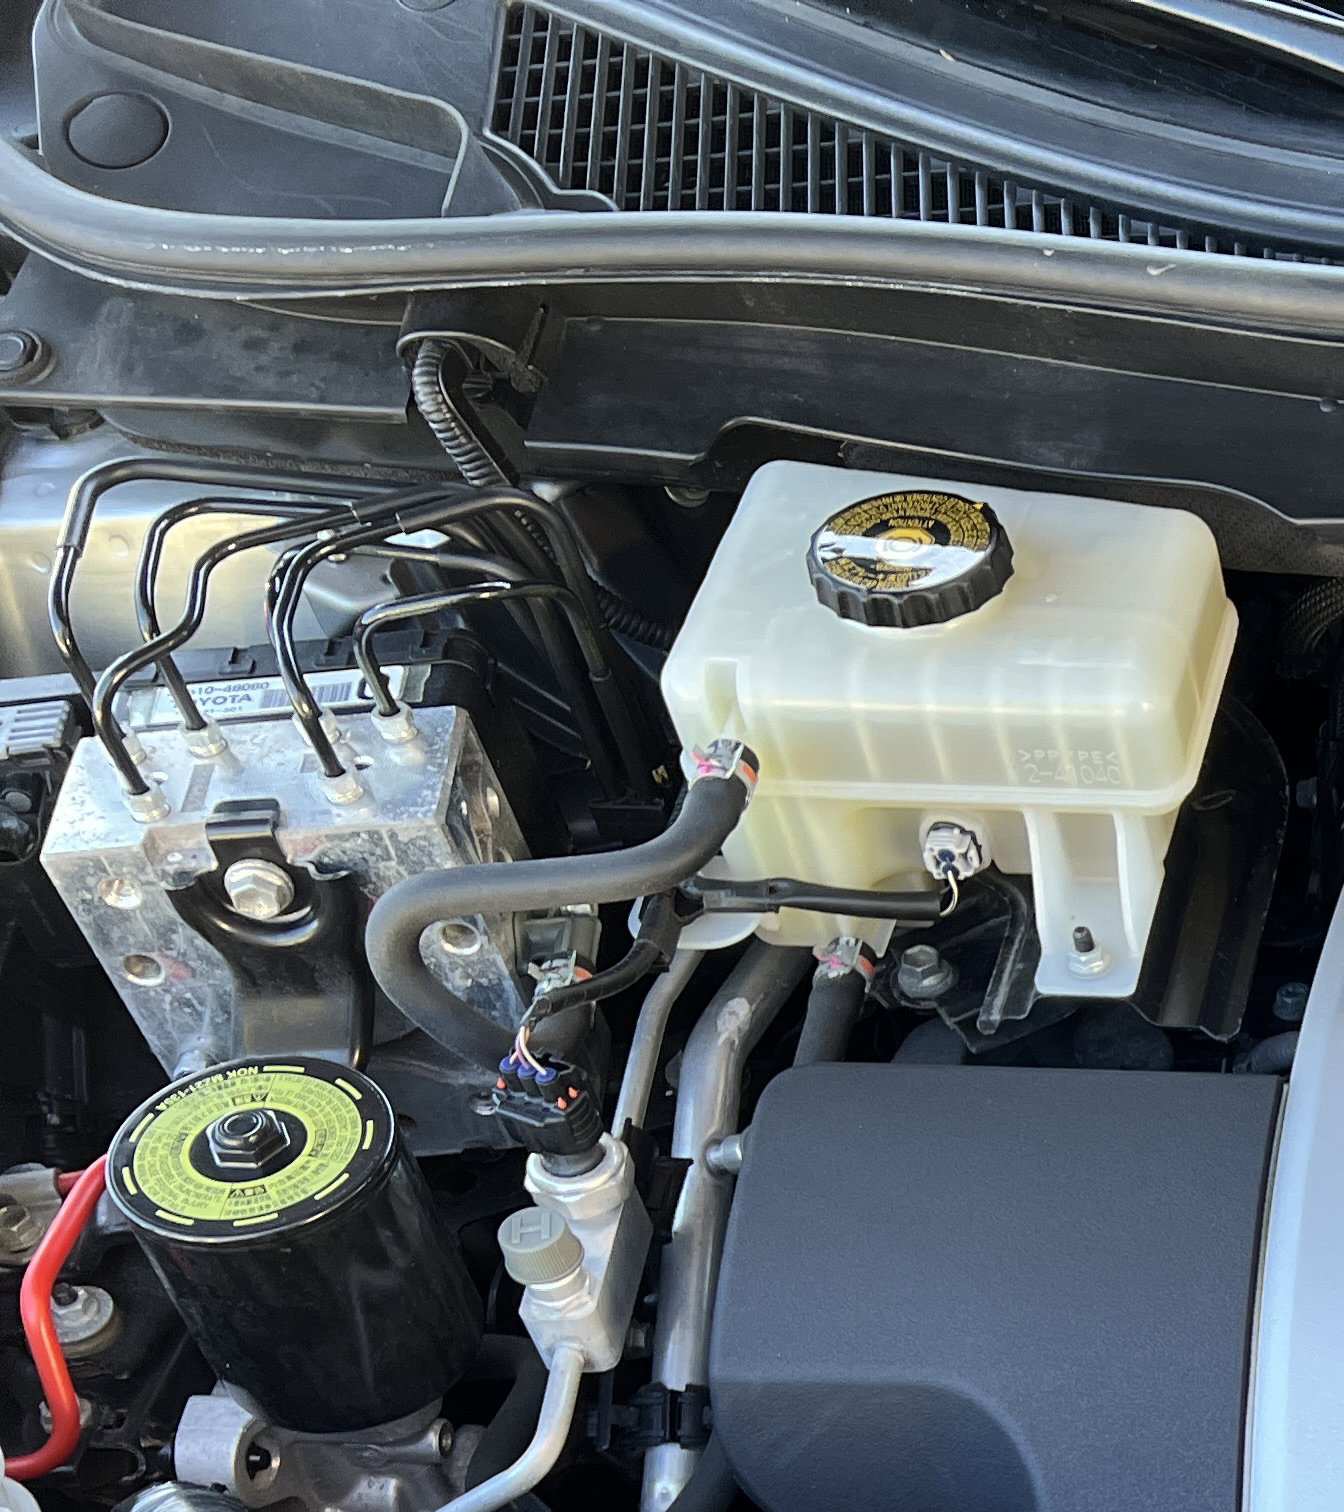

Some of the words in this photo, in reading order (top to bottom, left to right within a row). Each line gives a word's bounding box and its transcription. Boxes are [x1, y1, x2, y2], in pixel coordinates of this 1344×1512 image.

[888, 518, 935, 528] ATTENTION
[226, 1066, 259, 1080] NOK
[511, 1211, 552, 1245] H
